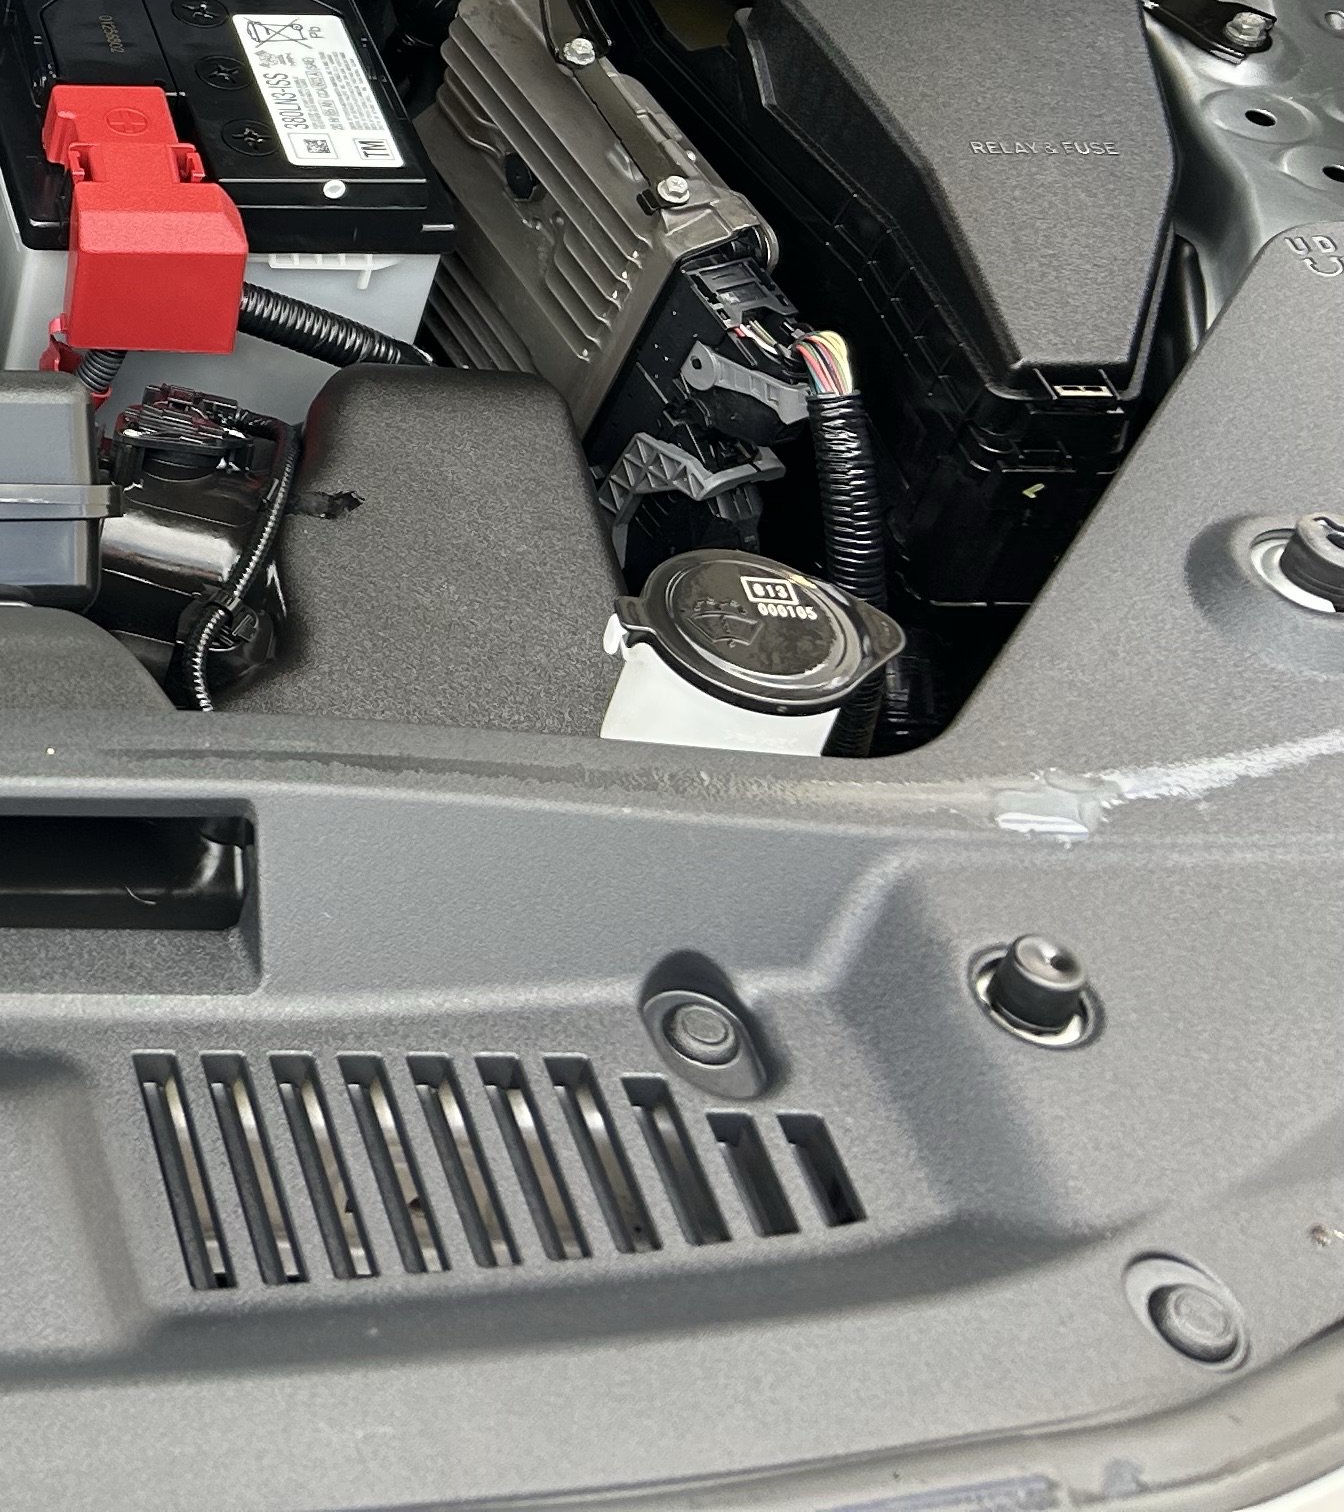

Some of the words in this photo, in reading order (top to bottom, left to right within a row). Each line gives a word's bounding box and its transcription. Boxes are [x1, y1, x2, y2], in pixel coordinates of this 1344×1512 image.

[309, 25, 323, 39] Pb
[263, 72, 310, 130] 380LN3-ISS
[358, 140, 391, 159] TM
[969, 141, 1037, 156] RELAY
[1044, 141, 1059, 155] &
[1062, 141, 1120, 156] FUSE
